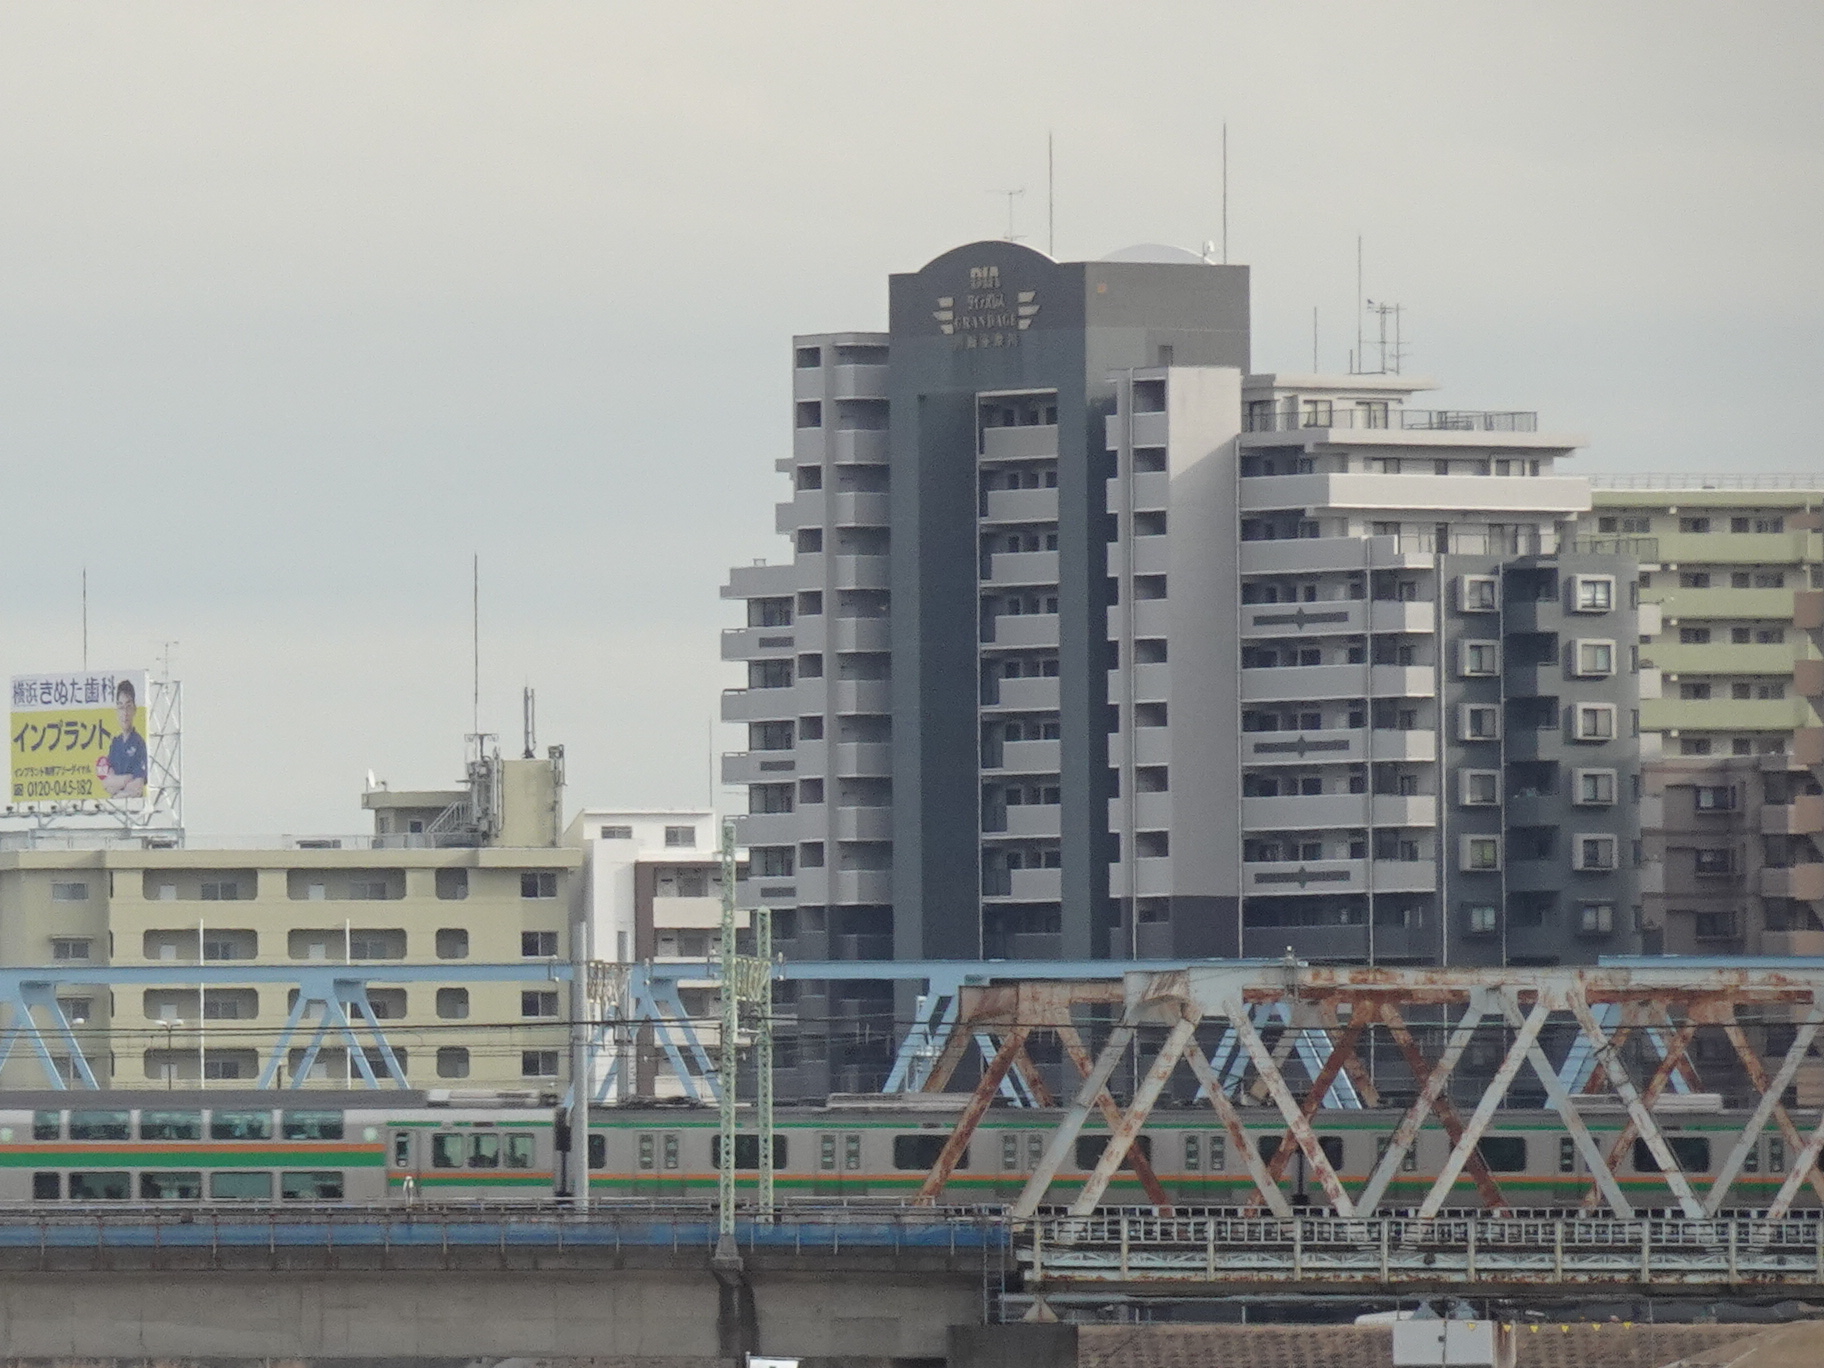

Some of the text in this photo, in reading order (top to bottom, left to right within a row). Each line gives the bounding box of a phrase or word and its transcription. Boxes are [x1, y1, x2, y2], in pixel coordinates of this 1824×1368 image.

[13, 674, 116, 706] 横浜きぬた歯科
[13, 719, 112, 752] インプラント
